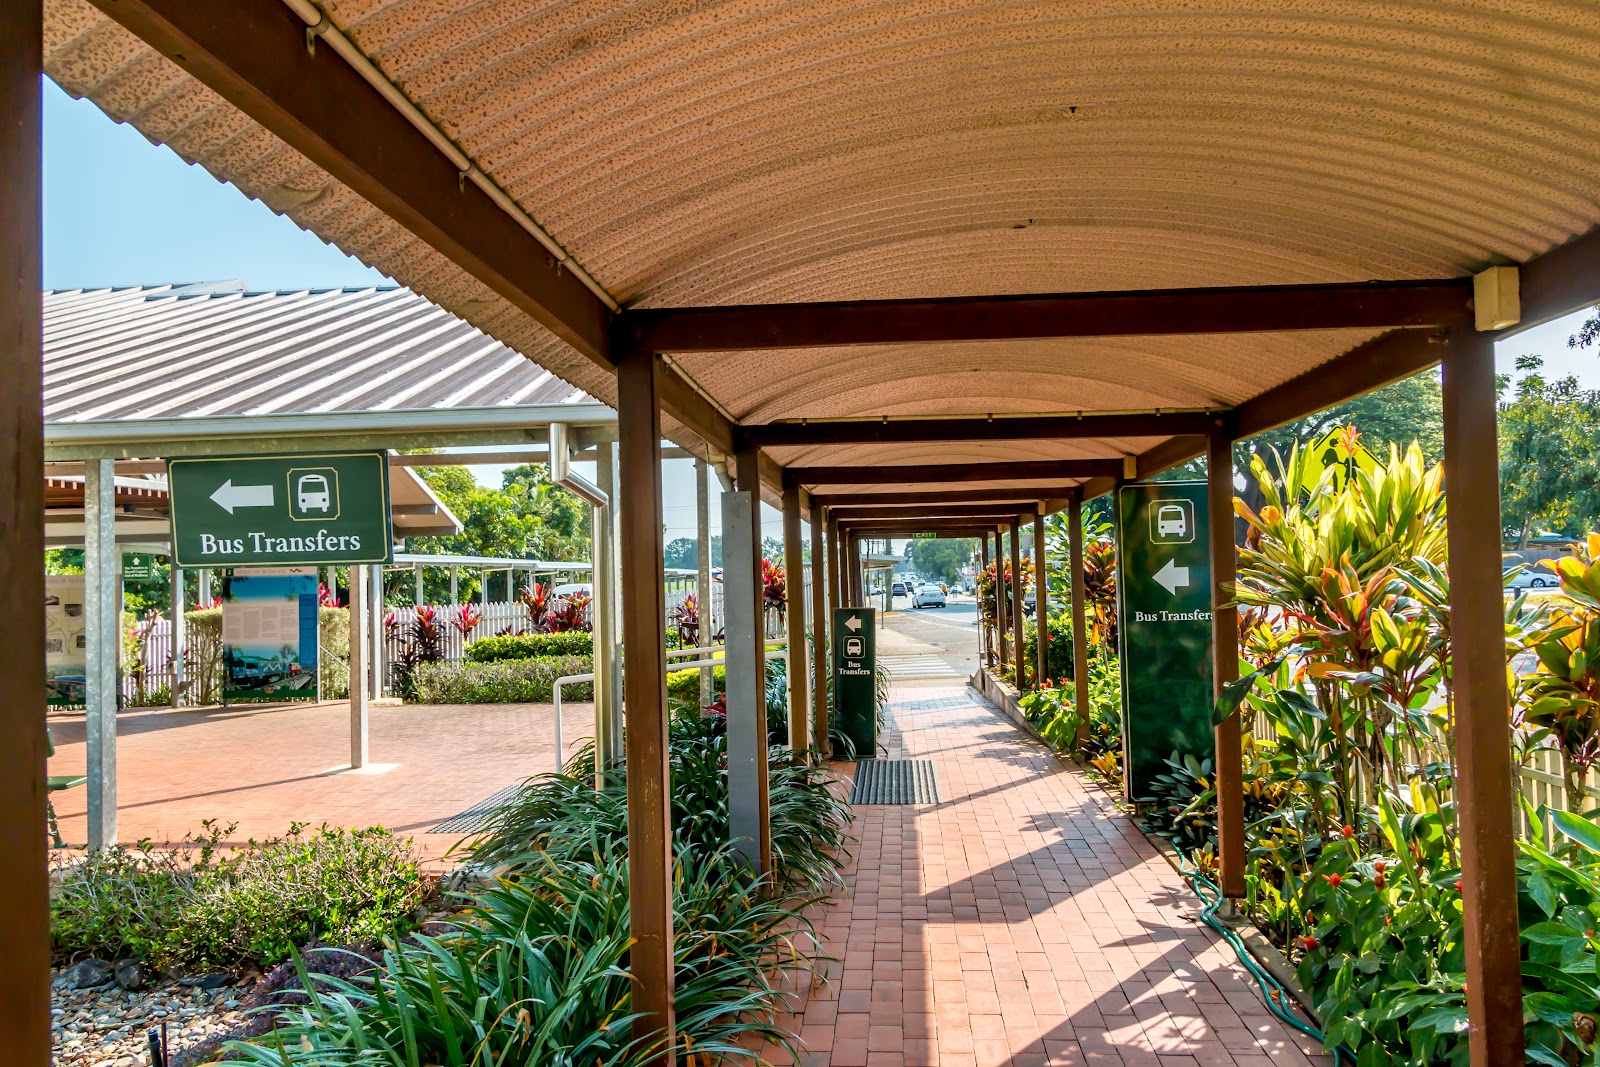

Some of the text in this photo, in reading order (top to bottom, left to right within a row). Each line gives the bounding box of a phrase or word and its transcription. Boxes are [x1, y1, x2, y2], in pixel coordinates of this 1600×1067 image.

[200, 529, 361, 555] Bus Transfers
[1135, 611, 1157, 621] Bus
